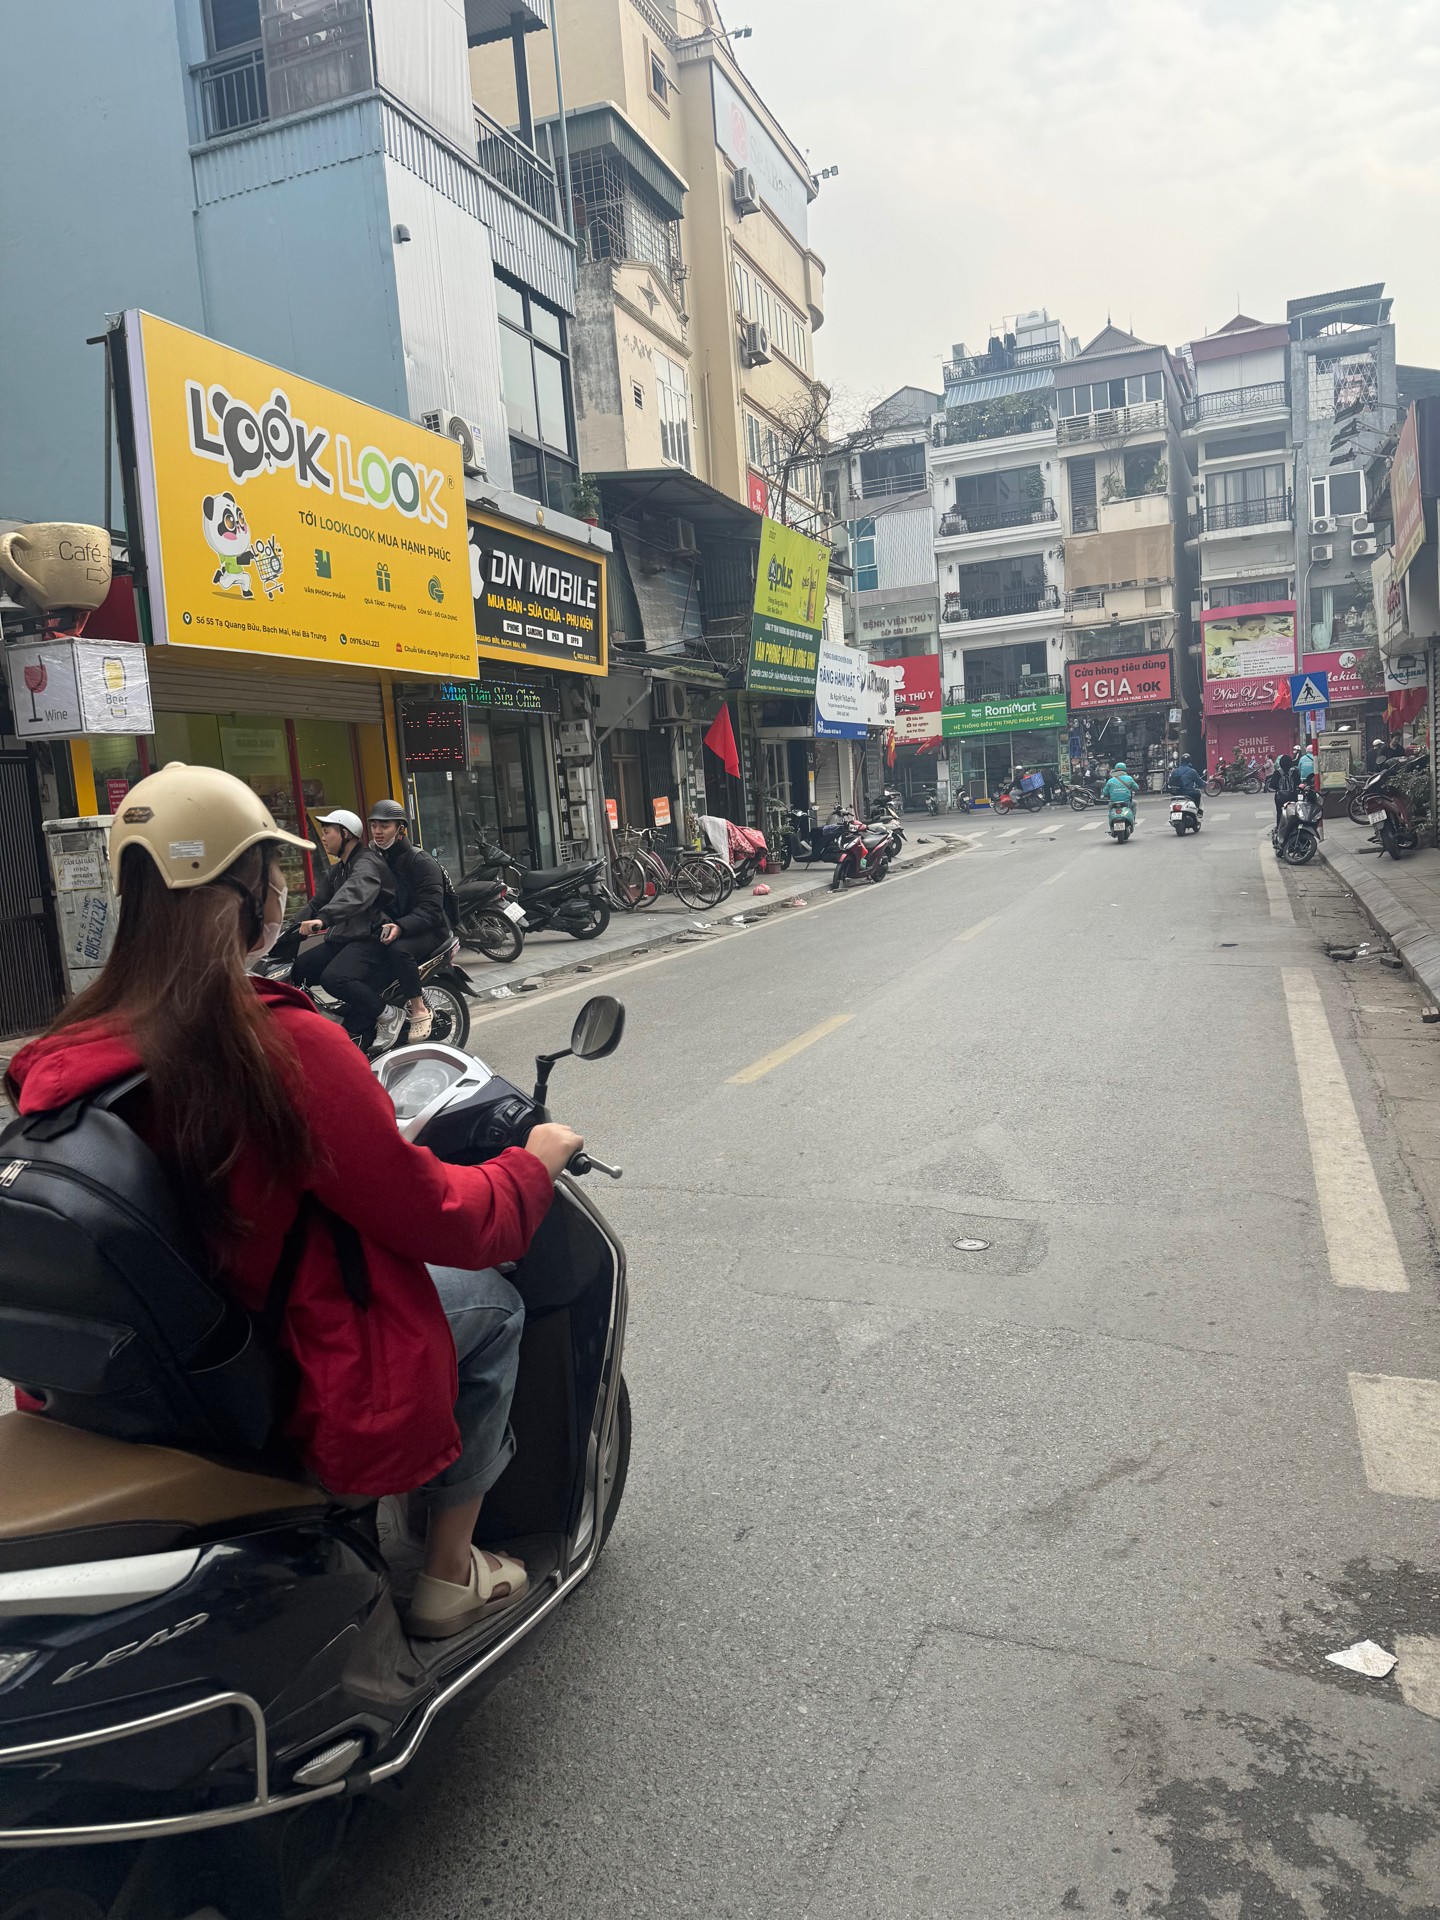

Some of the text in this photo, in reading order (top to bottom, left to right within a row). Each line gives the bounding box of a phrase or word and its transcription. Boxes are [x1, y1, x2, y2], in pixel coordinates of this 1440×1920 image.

[188, 387, 447, 524] LOOK LOOK
[298, 510, 452, 562] TỚI LOOKLOOK MUA HẠNH PHÚC
[490, 549, 598, 609] DN MOBILE
[487, 593, 594, 632] MUA BÁN SỬA CHỮA PHỤ KIỆN
[863, 619, 886, 630] BỆNH
[888, 616, 907, 628] VIỆN
[908, 612, 926, 624] THÚ
[196, 616, 205, 624] Số
[206, 617, 214, 626] 55
[215, 618, 224, 627] Tạ
[224, 620, 246, 632] Quang
[262, 625, 278, 634] Bạch
[310, 632, 327, 642] Trưng
[506, 622, 520, 633] IPHONE
[527, 626, 543, 638] SAMSUNG
[820, 665, 834, 684] RĂNG
[835, 669, 846, 687] HÀM
[1074, 660, 1166, 678] Cửa hàng tiêu dùng
[908, 690, 926, 701] THÚ
[928, 691, 935, 699] Y
[1082, 678, 1161, 700] 1 GIA 10K
[106, 694, 128, 705] Beer
[44, 709, 68, 722] Wine
[985, 702, 1037, 716] RomiMart
[1238, 736, 1269, 747] SHINE
[1258, 746, 1275, 754] LIFE
